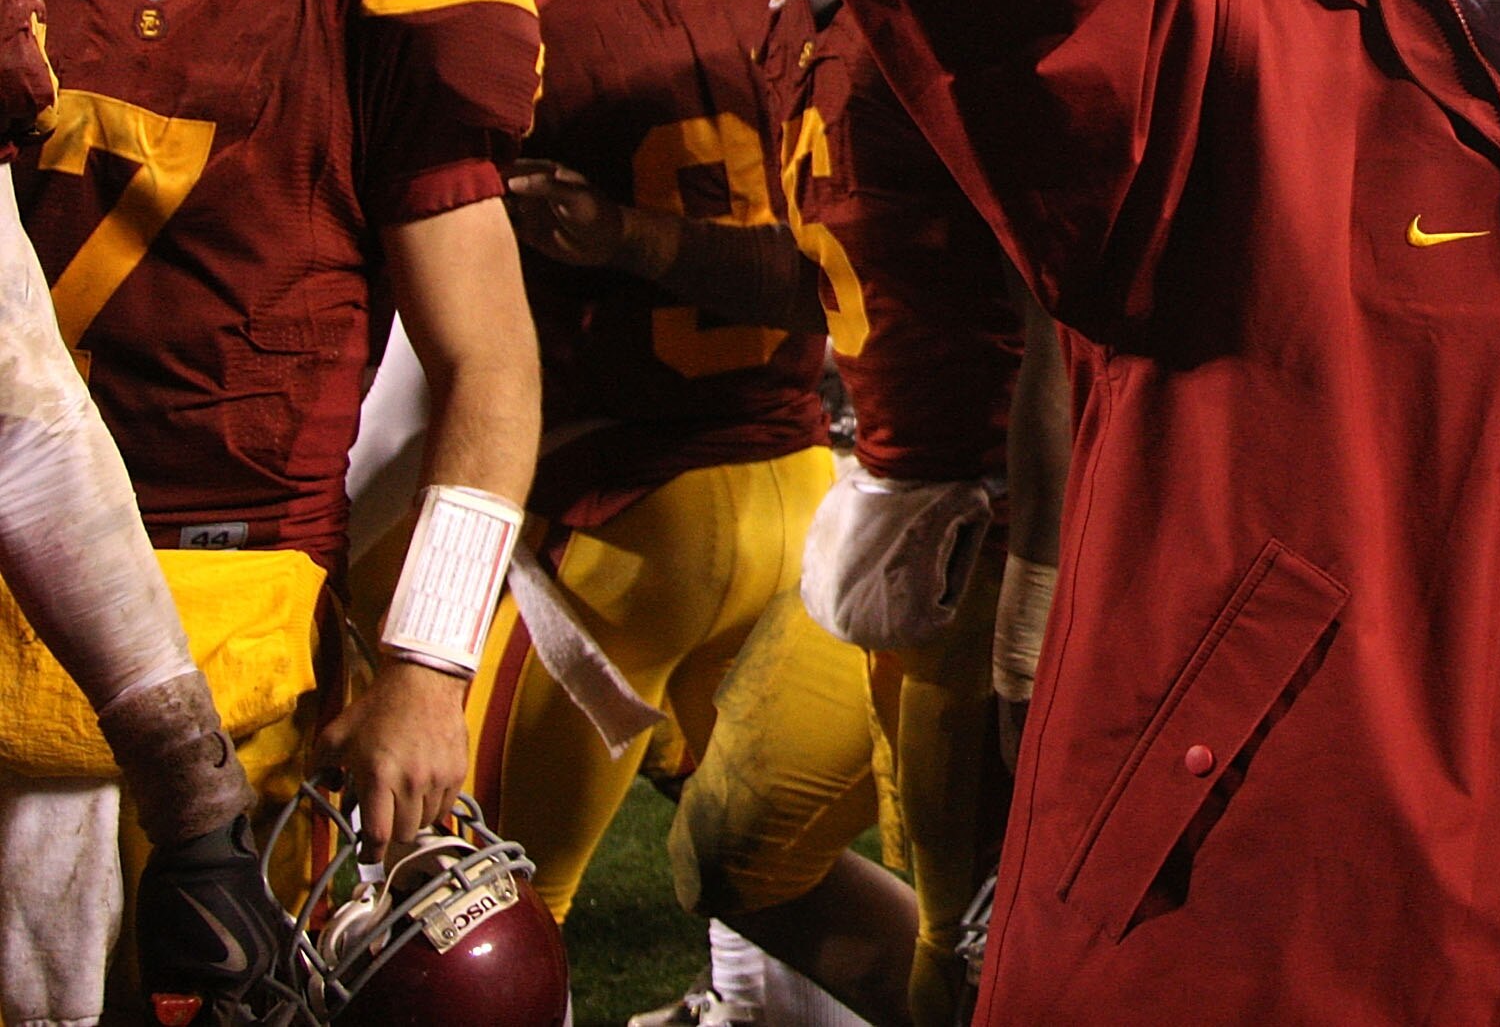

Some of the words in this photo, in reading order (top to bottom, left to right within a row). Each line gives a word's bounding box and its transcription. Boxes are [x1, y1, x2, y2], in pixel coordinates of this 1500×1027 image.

[38, 88, 216, 386] 7
[191, 531, 230, 546] 44
[453, 895, 498, 930] USC
